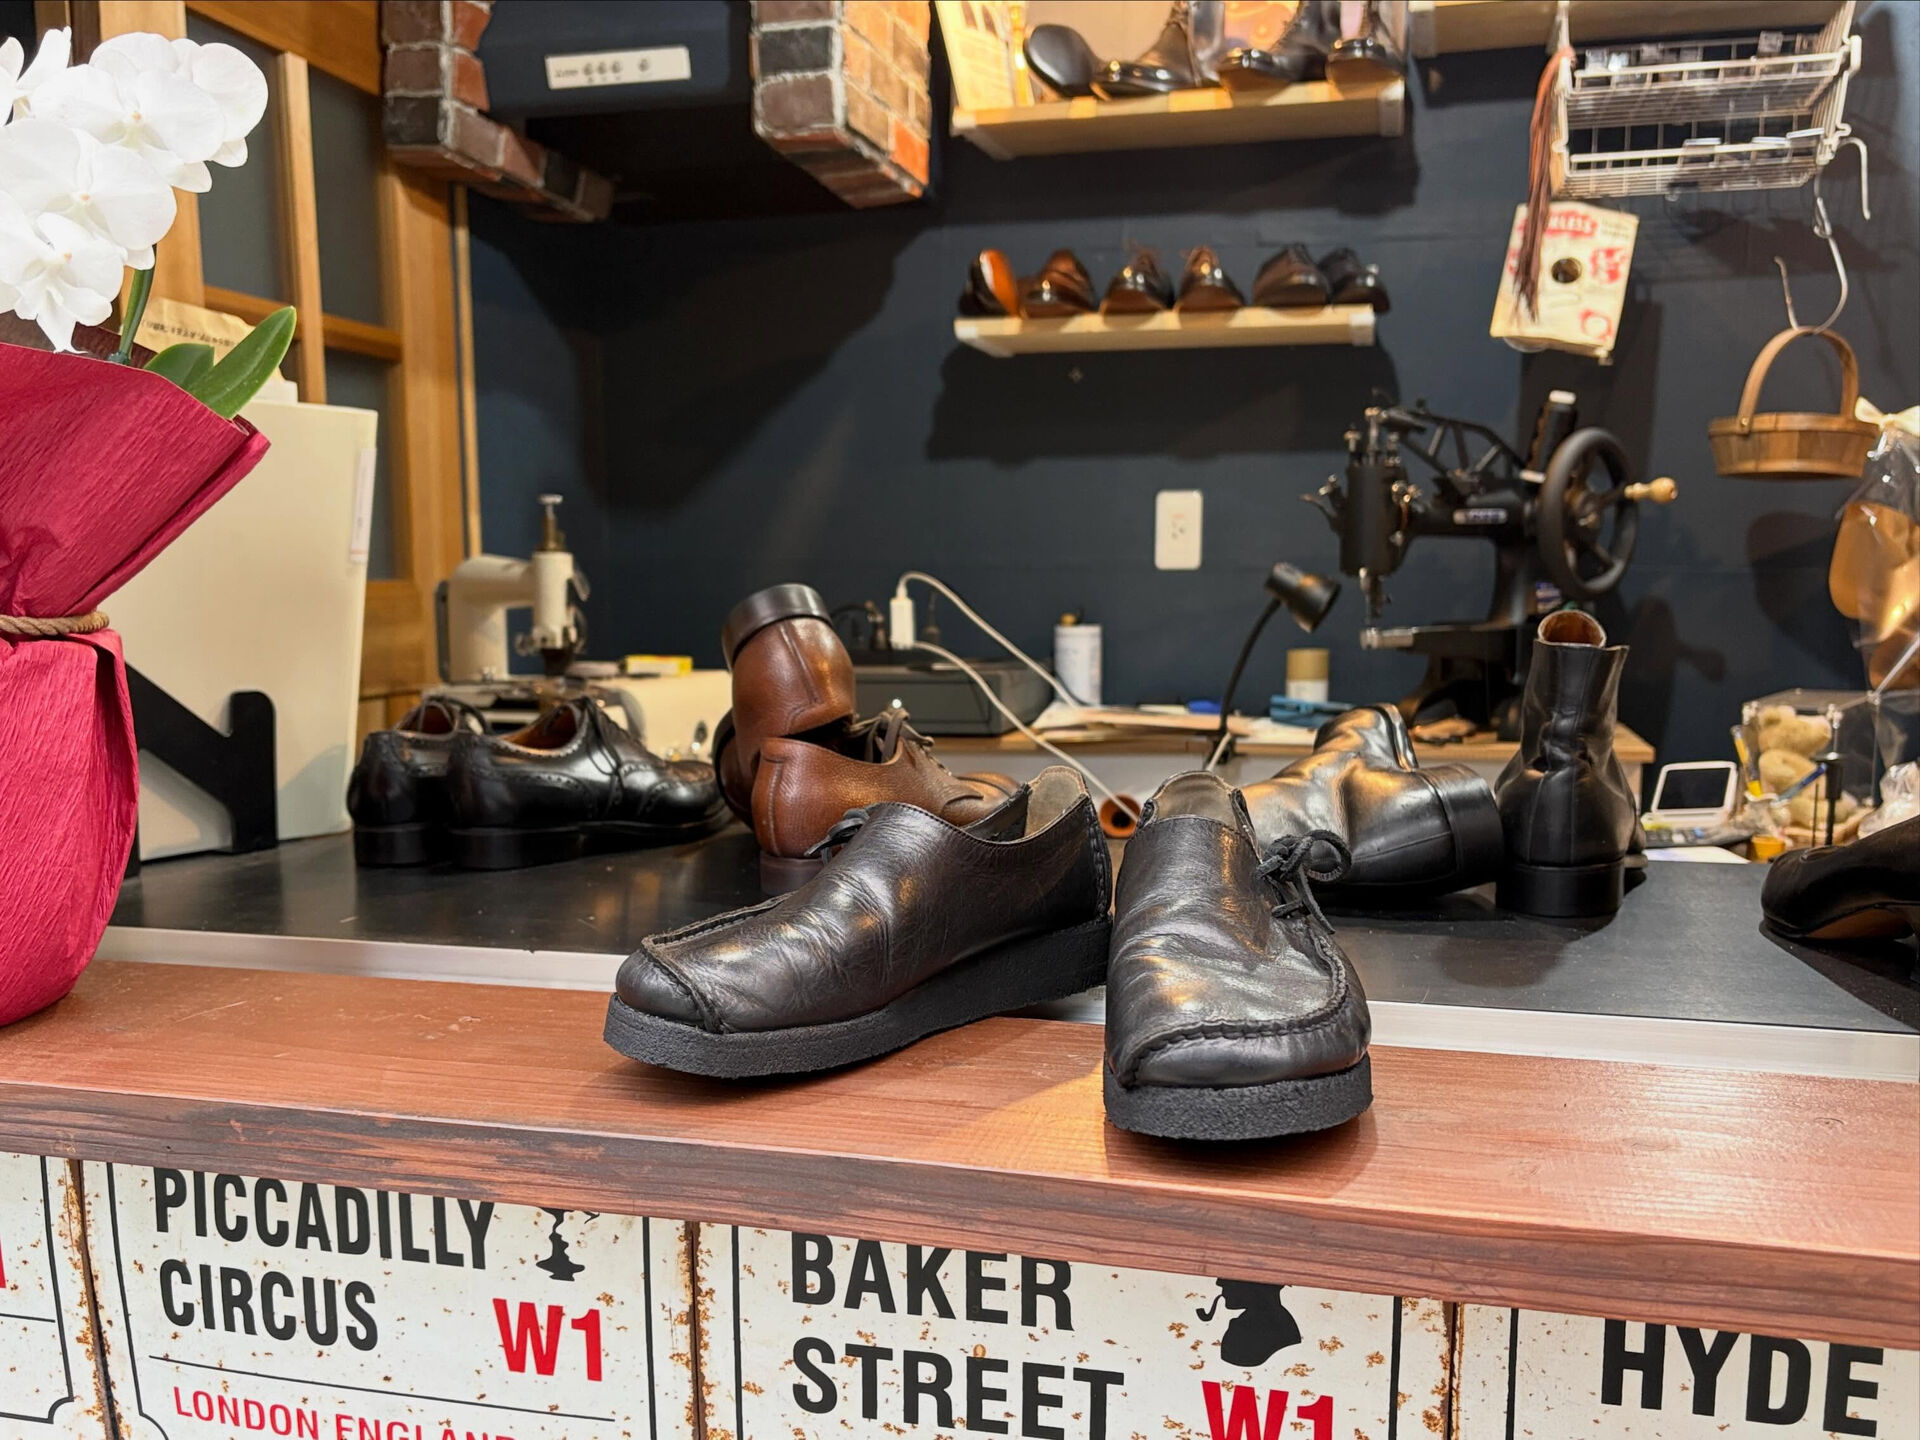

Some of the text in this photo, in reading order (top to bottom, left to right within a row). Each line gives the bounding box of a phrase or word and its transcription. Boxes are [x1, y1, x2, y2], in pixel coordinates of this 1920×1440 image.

[153, 1166, 495, 1270] PICCADILLY
[159, 1257, 379, 1352] CIRCUS
[791, 1231, 1075, 1332] BAKER
[492, 1297, 603, 1383] W1
[792, 1335, 1125, 1440] STREET
[1600, 1317, 1885, 1439] HYDE
[173, 1386, 319, 1440] LONDON
[1201, 1380, 1334, 1440] W1
